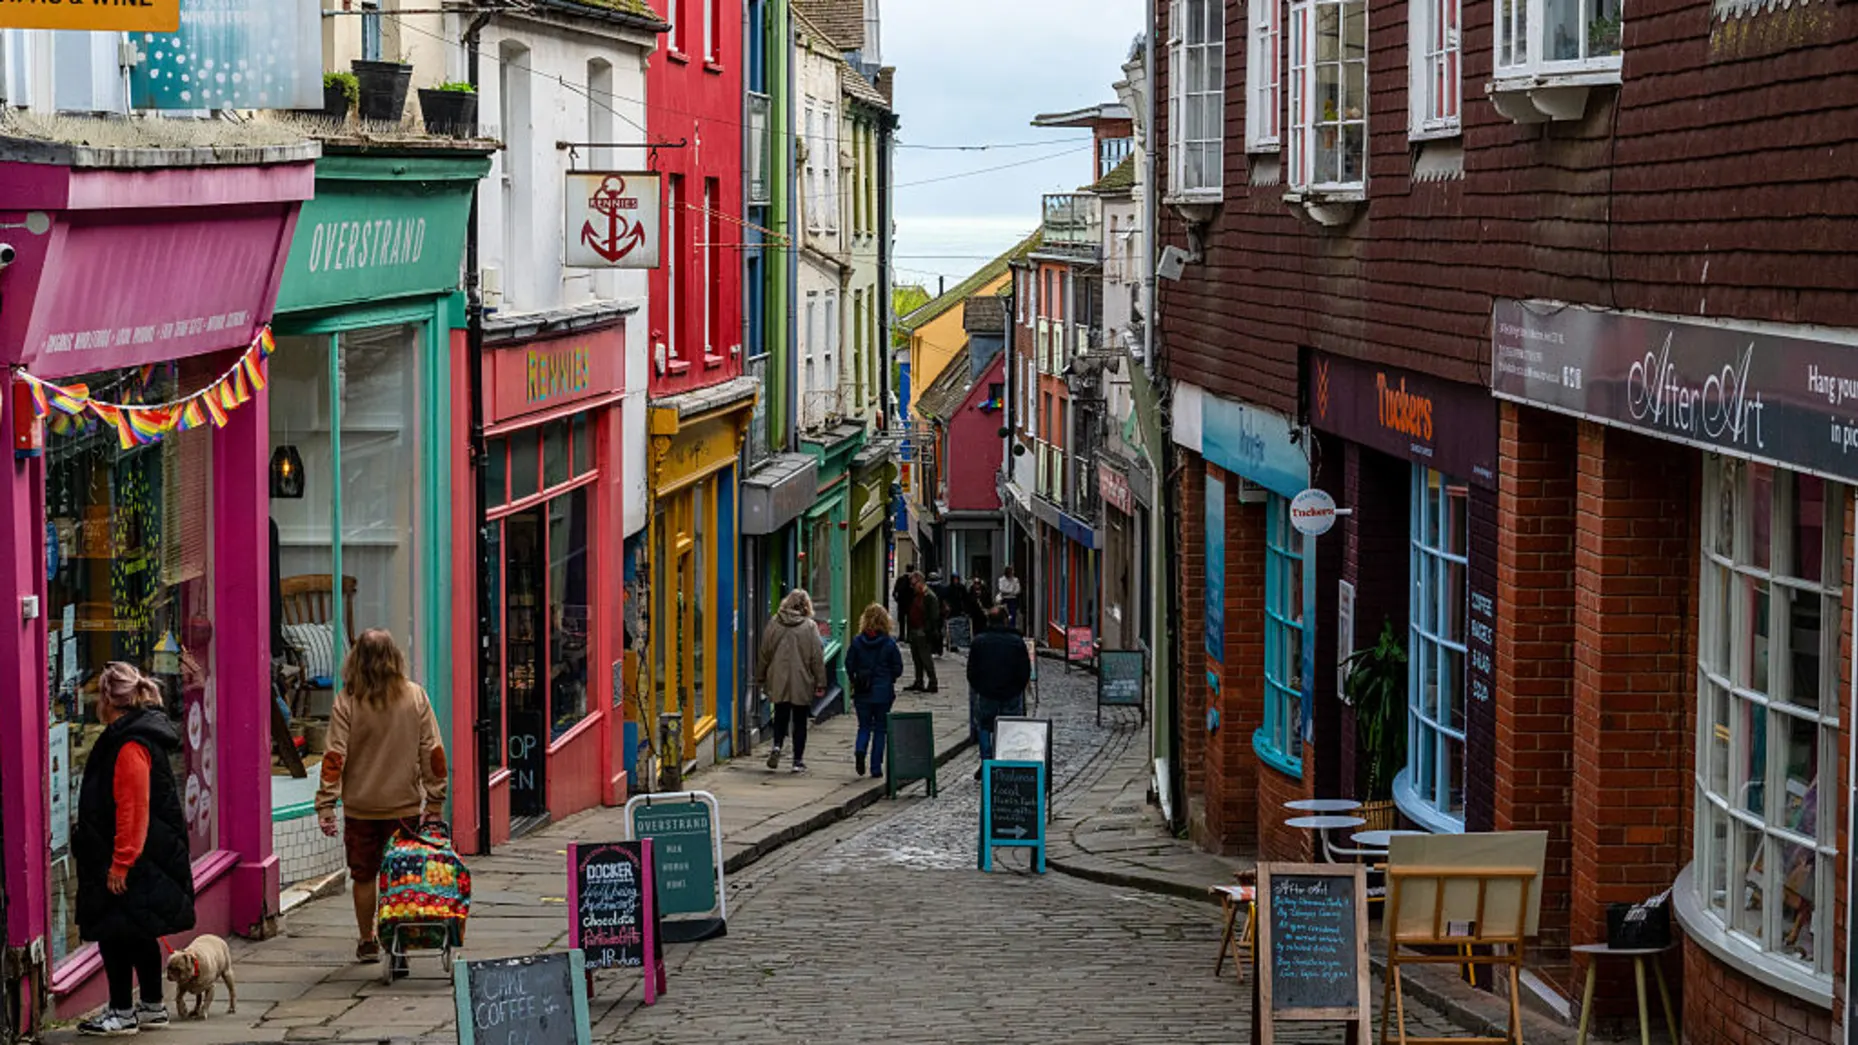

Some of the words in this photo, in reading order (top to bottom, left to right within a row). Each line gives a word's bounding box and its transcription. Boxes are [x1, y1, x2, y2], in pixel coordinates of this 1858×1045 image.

[309, 217, 426, 273] OVERSTRAND
[526, 346, 590, 404] RENNIES
[1627, 330, 1700, 432] After
[1702, 341, 1764, 449] Art
[1808, 364, 1836, 404] Hang
[1376, 371, 1433, 441] Tuckers
[1831, 415, 1842, 444] in
[1471, 591, 1493, 617] COFFEE
[637, 817, 708, 832] OVERSTRAND
[586, 862, 633, 880] DOCKER
[484, 969, 528, 1000] CAKE
[476, 996, 536, 1030] COFFEE
